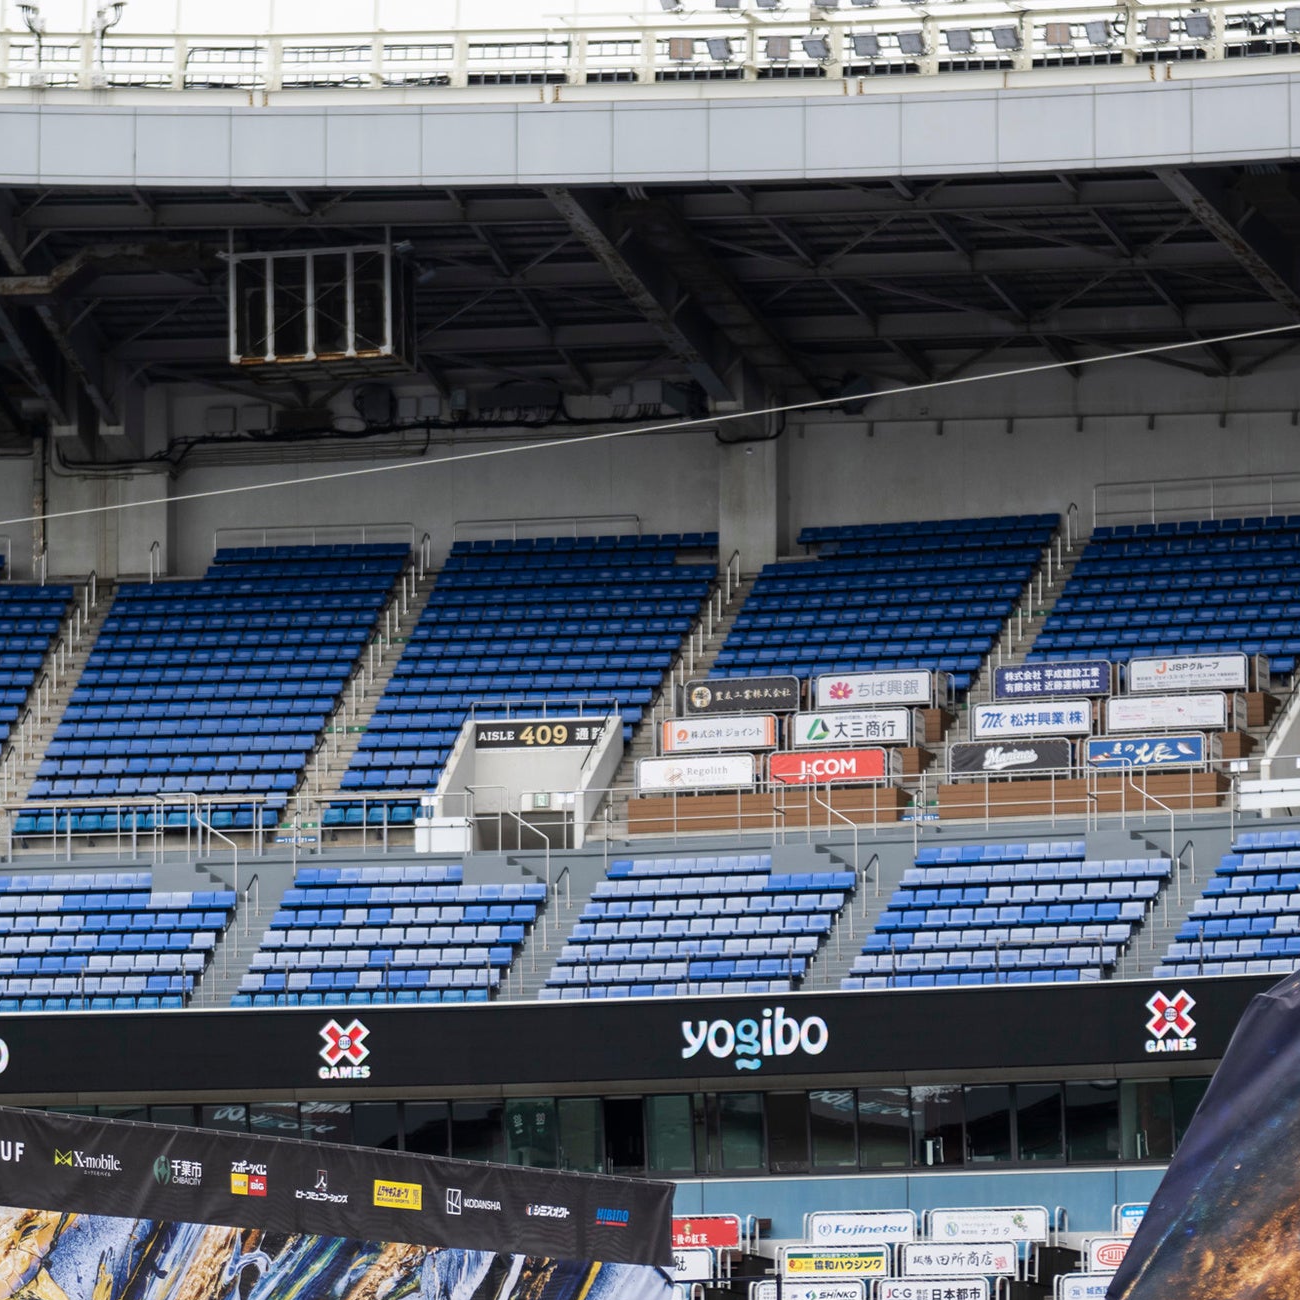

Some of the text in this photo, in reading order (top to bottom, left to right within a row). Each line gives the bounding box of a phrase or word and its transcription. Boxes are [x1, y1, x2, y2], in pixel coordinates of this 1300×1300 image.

[1168, 661, 1219, 672] JSPグループ
[1004, 670, 1041, 682] 株式会社
[856, 679, 919, 697] ちば興銀
[1004, 682, 1042, 693] 有限会社
[478, 730, 515, 742] AISLE
[519, 725, 569, 745] 409
[690, 728, 763, 739] 株式会社 ジョイント
[834, 720, 896, 739] 大三商行
[686, 766, 729, 778] Regolith
[798, 757, 857, 781] J:COM
[682, 1006, 829, 1071] yogibo
[1145, 1037, 1197, 1053] GAMES
[318, 1066, 371, 1080] GAMES
[171, 1160, 202, 1178] 千葉市
[231, 1160, 267, 1175] スポーツくじ
[464, 1198, 502, 1212] KODANSHA
[533, 1204, 570, 1219] シミズオクト
[834, 1223, 908, 1237] Fujinetsu
[981, 1226, 1012, 1236] ナガタ
[935, 1251, 994, 1267] 田所商店
[931, 1287, 981, 1300] 日本都市
